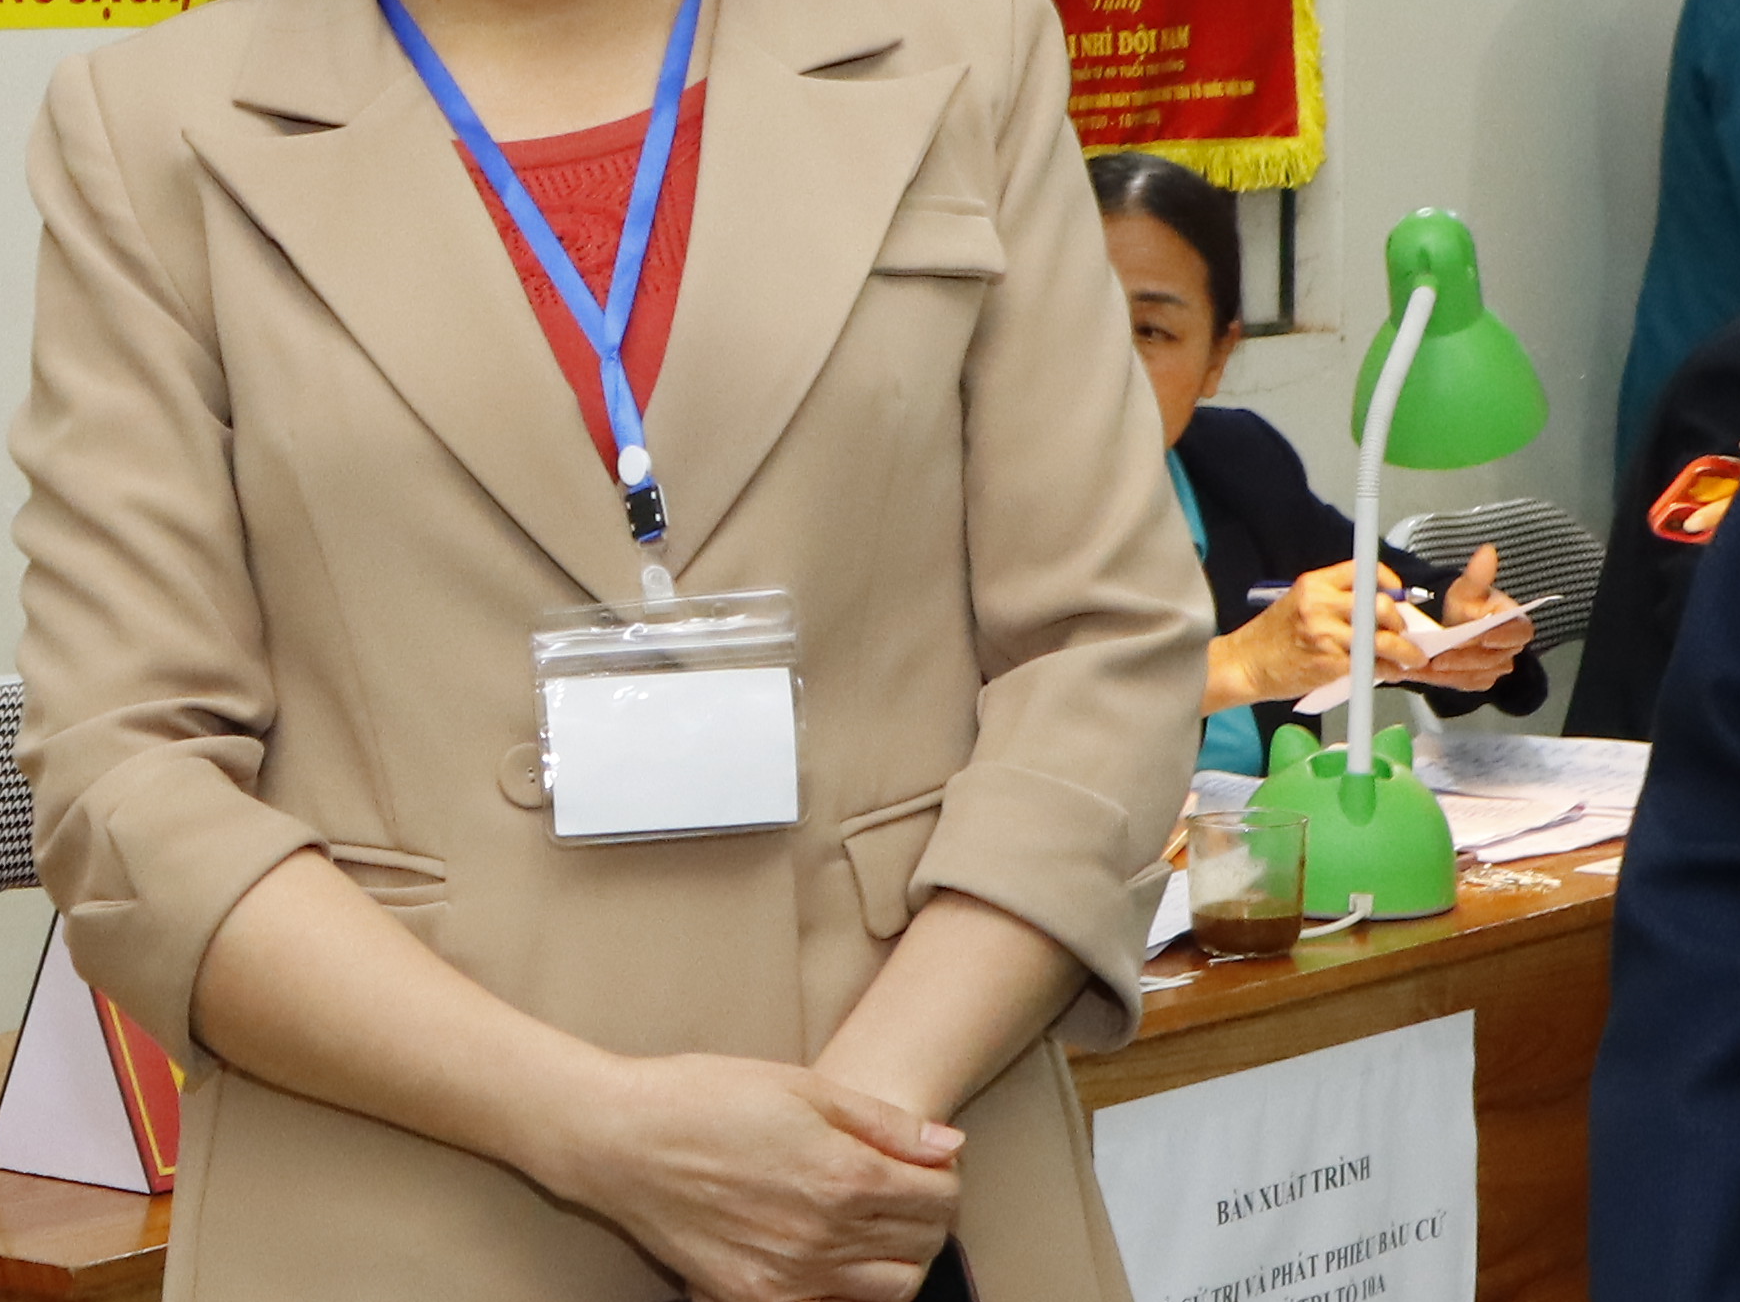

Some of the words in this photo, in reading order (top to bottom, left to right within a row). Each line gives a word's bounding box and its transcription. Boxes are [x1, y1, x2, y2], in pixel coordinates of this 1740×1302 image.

[1118, 23, 1158, 56] ĐỘI
[1258, 1170, 1307, 1213] XUẤT
[1311, 1154, 1371, 1194] TRÌNH
[1271, 1251, 1320, 1291] PHÁT
[1324, 1232, 1376, 1275] PHIẾU
[1361, 1272, 1387, 1301] 10A
